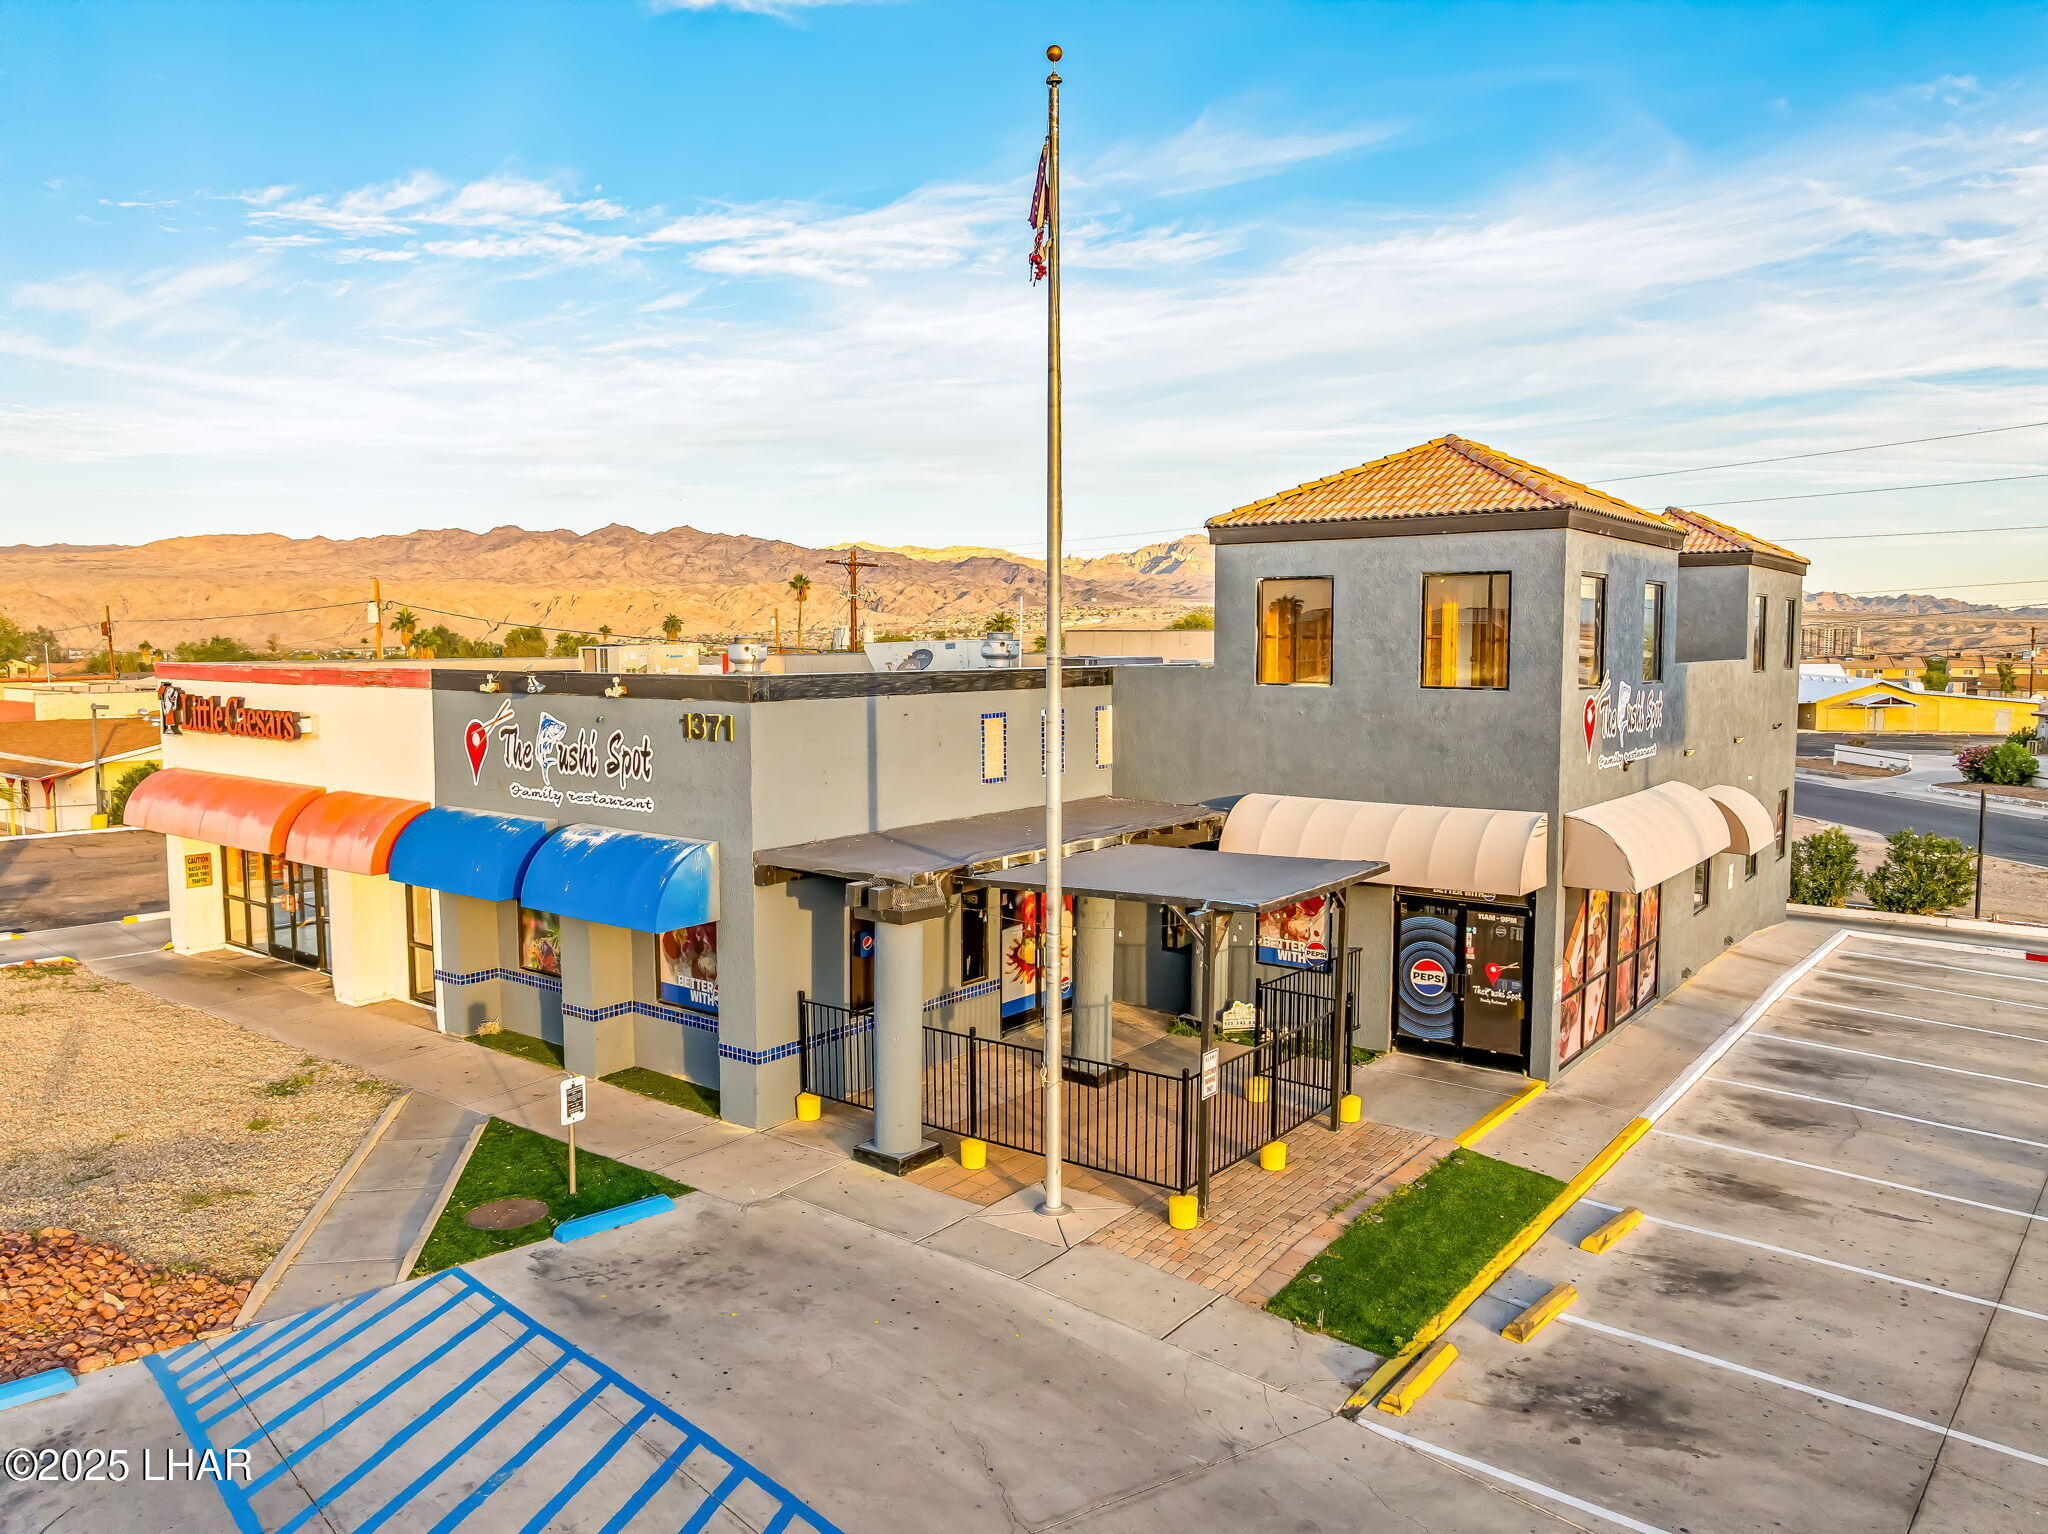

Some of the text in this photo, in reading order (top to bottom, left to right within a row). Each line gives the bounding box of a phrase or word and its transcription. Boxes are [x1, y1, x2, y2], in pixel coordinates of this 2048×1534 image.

[180, 693, 296, 742] Little Caesars
[679, 712, 734, 742] 1371
[500, 724, 533, 771] The
[605, 729, 653, 790] Spot
[511, 783, 654, 812] Family restaurant
[188, 856, 208, 864] CAUTION
[1263, 936, 1306, 952] BETTER
[1278, 950, 1328, 964] WITH PEPSI
[678, 972, 714, 993] BETTER
[1414, 972, 1445, 984] PEPSI
[690, 990, 715, 1006] WITH
